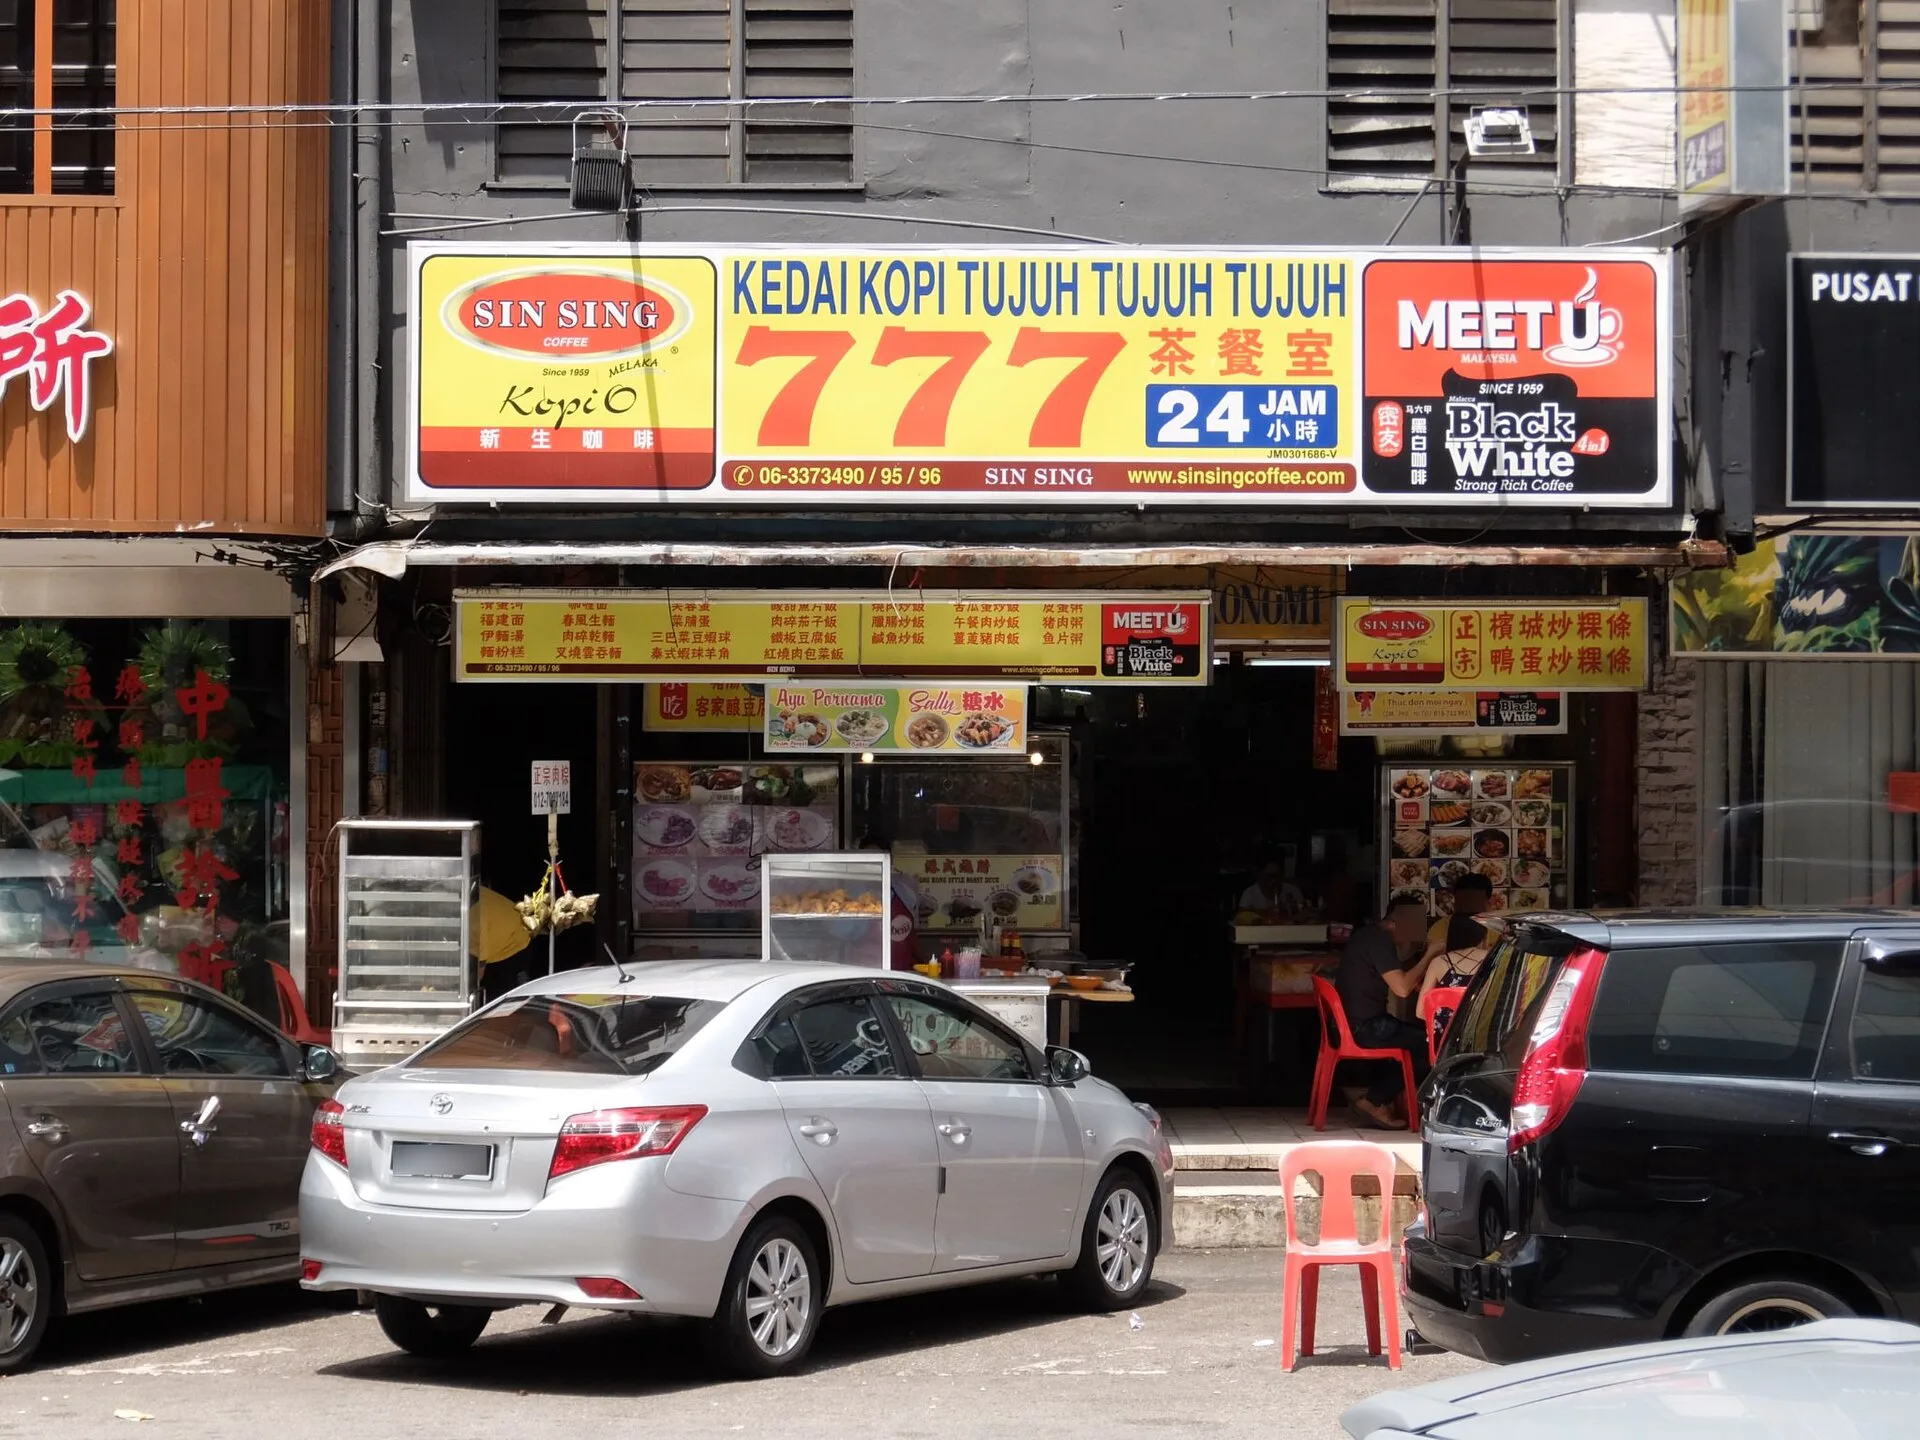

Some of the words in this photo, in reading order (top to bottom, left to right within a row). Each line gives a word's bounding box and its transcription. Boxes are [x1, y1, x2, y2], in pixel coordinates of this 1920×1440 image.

[733, 260, 847, 315] KEDAI
[859, 259, 945, 316] KOPI
[957, 261, 1078, 317] TUJUH
[1091, 262, 1212, 317] TUJUH
[1225, 263, 1346, 318] TUJUH
[1812, 272, 1912, 302] PUSAT
[474, 300, 547, 329] SIN
[558, 300, 659, 329] SING
[1398, 300, 1554, 350] MEET
[543, 337, 589, 347] COFFEE
[1148, 327, 1333, 377] 茶餐室
[608, 358, 658, 378] MELAKA
[1460, 353, 1517, 363] MALAYSIA
[542, 368, 567, 377] Since
[569, 368, 590, 377] 1959
[734, 325, 1128, 448] 777
[1479, 383, 1514, 394] SINCE
[1517, 383, 1544, 394] 1959
[499, 385, 599, 430] Kopi
[604, 384, 637, 414] O
[1259, 390, 1327, 415] JAM
[1405, 404, 1432, 415] 马六甲
[1157, 389, 1250, 443] 24
[1445, 402, 1575, 442] Black
[480, 428, 654, 450] 新生咖啡
[1267, 419, 1319, 443] 小時
[1267, 449, 1337, 459] JM0301686-V
[1411, 418, 1428, 486] 黑白咖啡
[1445, 442, 1575, 477] White
[759, 466, 865, 485] 06-3373490
[880, 466, 903, 485] 95
[918, 466, 941, 485] 96
[985, 468, 1027, 485] SIN
[1034, 468, 1094, 485] SING
[1127, 466, 1345, 489] www.sinsingcoffee.com
[1454, 479, 1496, 493] Strong
[1500, 479, 1527, 491] Rich
[1530, 479, 1574, 491] Coffee
[1214, 584, 1322, 625] ONOMI
[1113, 612, 1165, 629] MEET
[1363, 620, 1388, 631] SIN
[1391, 620, 1425, 631] SING
[1129, 646, 1173, 660] Black
[1455, 615, 1477, 674] 正宗
[1001, 666, 1079, 674] www.sinsingcoffee.com
[1129, 659, 1173, 671] White
[1489, 646, 1632, 675] 鴨蛋炒粿條
[776, 688, 806, 710] Ayu
[908, 690, 961, 714] Sally
[962, 691, 1005, 712] 糖水
[1500, 699, 1537, 711] Black
[1500, 711, 1537, 722] White
